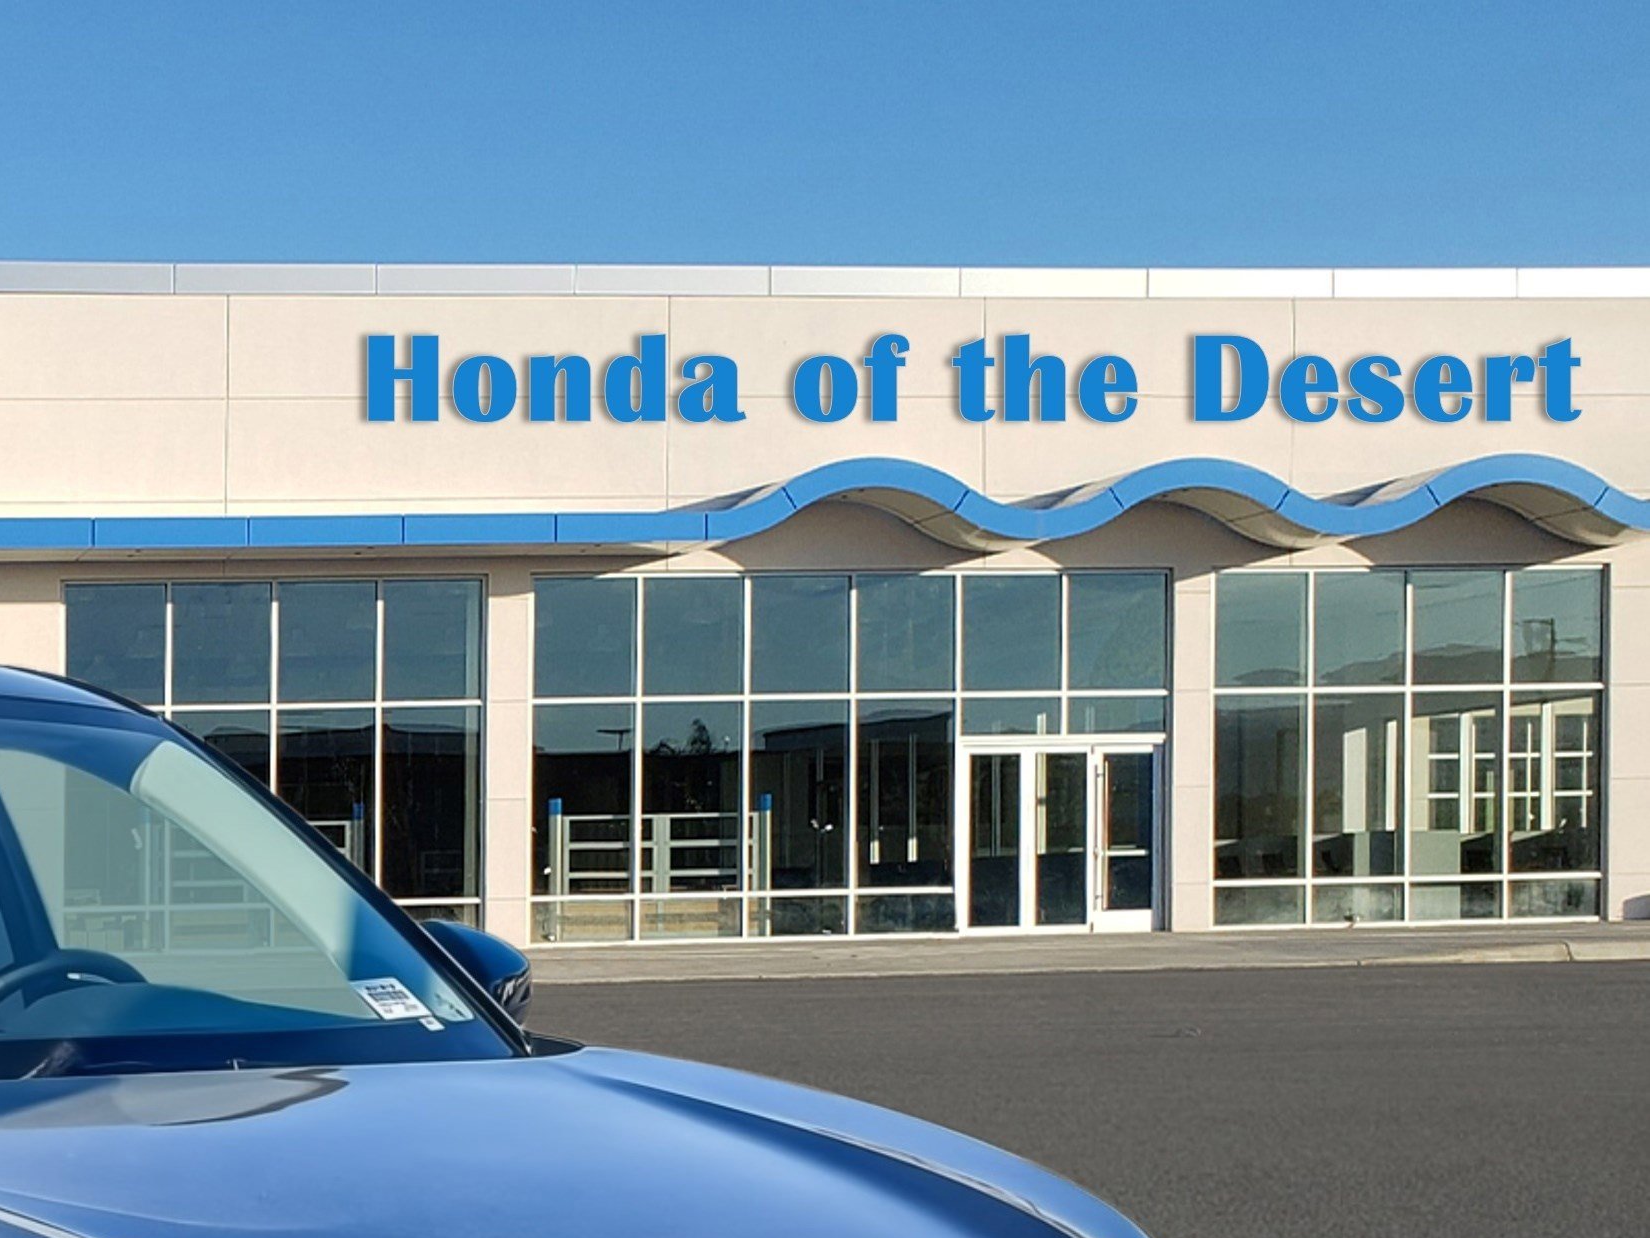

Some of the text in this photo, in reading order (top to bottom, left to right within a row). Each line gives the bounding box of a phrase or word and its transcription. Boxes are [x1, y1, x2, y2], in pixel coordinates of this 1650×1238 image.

[365, 332, 1584, 424] Honda of the Desert
